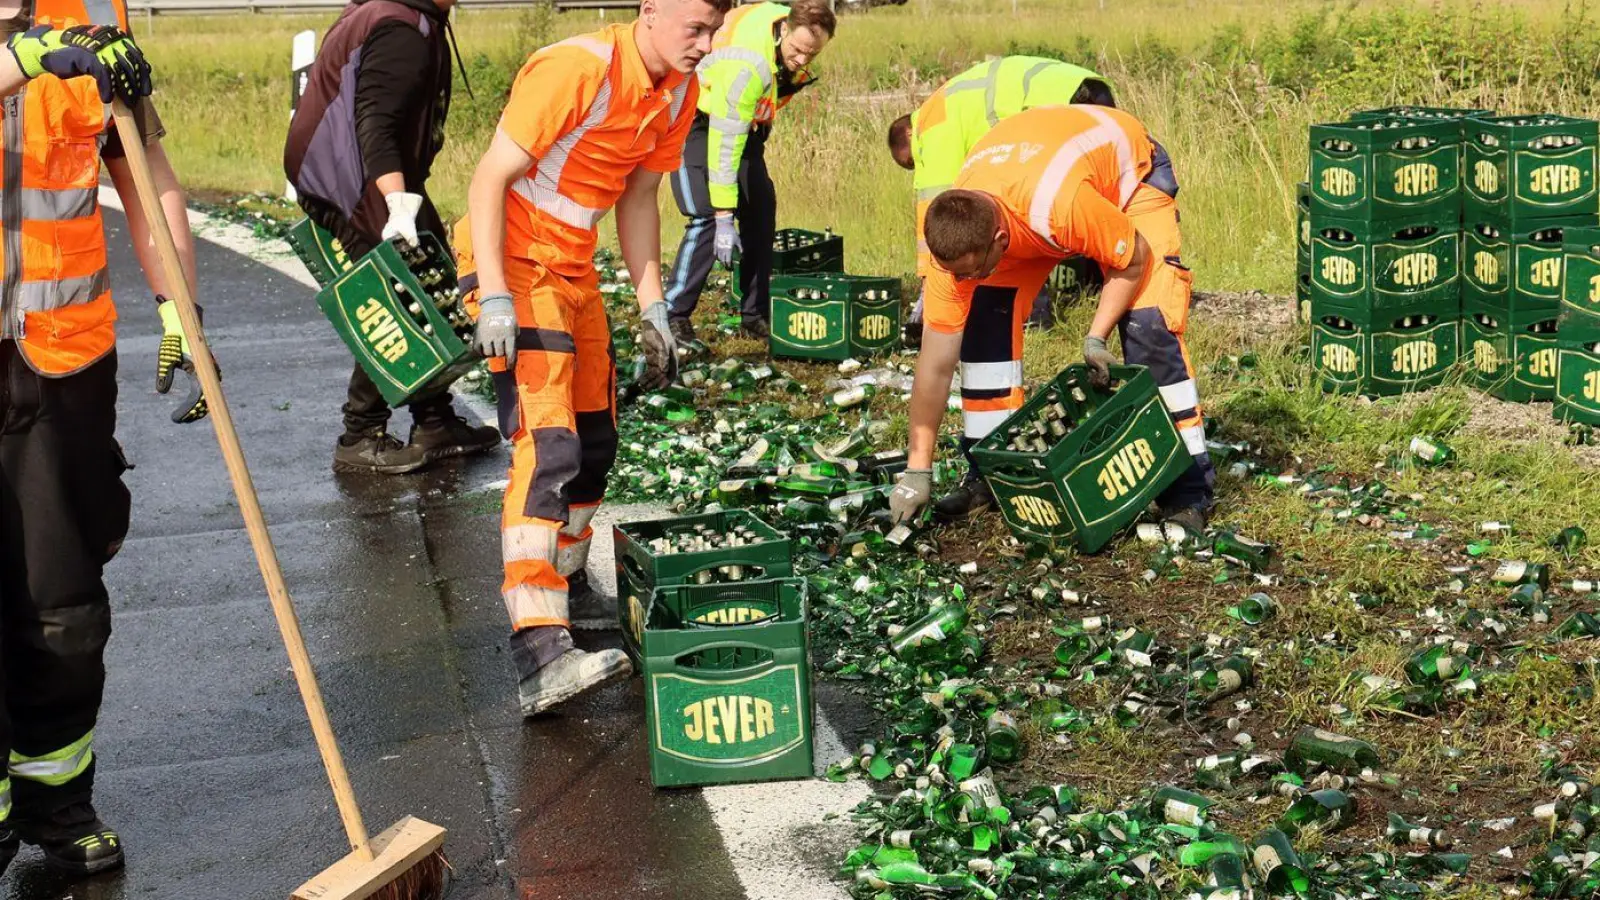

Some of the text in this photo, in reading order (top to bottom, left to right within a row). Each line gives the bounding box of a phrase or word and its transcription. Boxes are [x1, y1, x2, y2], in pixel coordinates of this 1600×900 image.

[1321, 167, 1356, 196] JEVER
[1394, 163, 1438, 196] JEVER
[1530, 165, 1580, 195] JEVER
[1321, 256, 1356, 285] JEVER
[1394, 253, 1438, 286] JEVER
[1531, 258, 1560, 287] JEV
[356, 297, 409, 363] JEVER
[788, 311, 828, 341] JEVER
[859, 314, 891, 340] JEVER
[1321, 343, 1356, 373] JEVER
[1392, 341, 1437, 373] JEVER
[1529, 348, 1557, 377] JEV
[1097, 438, 1156, 501] JEVER
[1009, 495, 1062, 527] JEVER
[683, 695, 775, 744] JEVER
